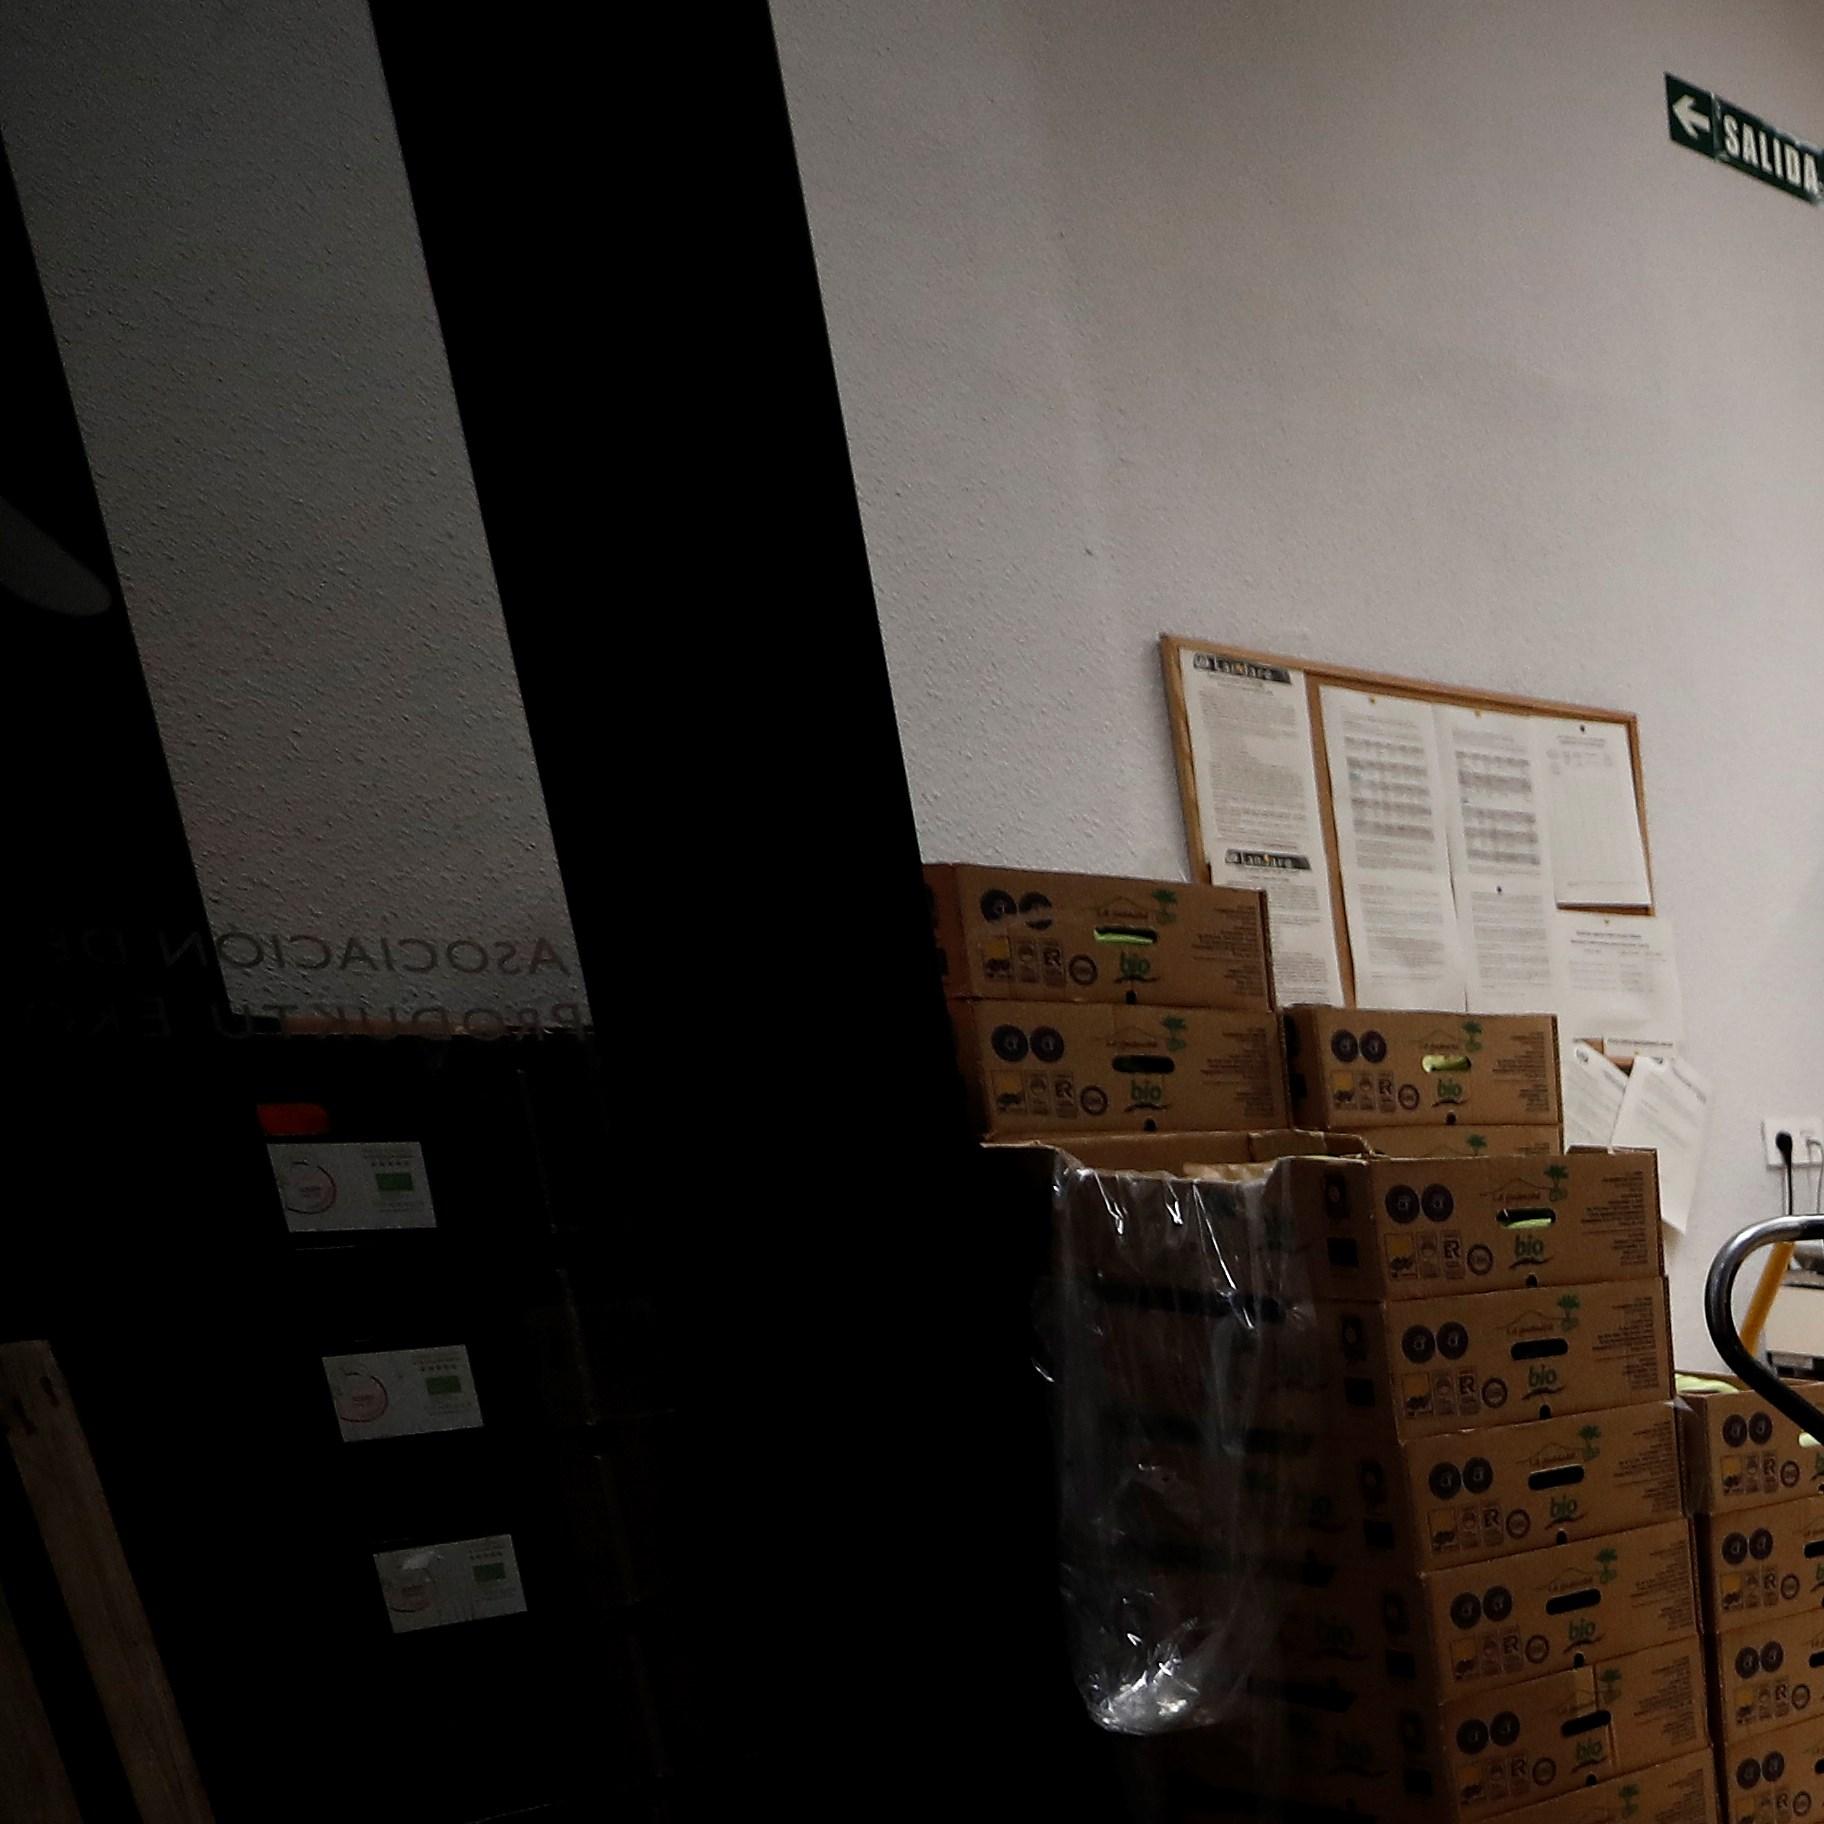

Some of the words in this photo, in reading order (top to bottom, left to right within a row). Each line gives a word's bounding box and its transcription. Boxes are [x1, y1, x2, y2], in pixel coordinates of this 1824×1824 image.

[1722, 114, 1821, 195] SALIDA
[1515, 1234, 1544, 1257] bio
[1528, 1363, 1557, 1387] bio
[1549, 1493, 1579, 1519] bio
[1569, 1616, 1597, 1641] bio
